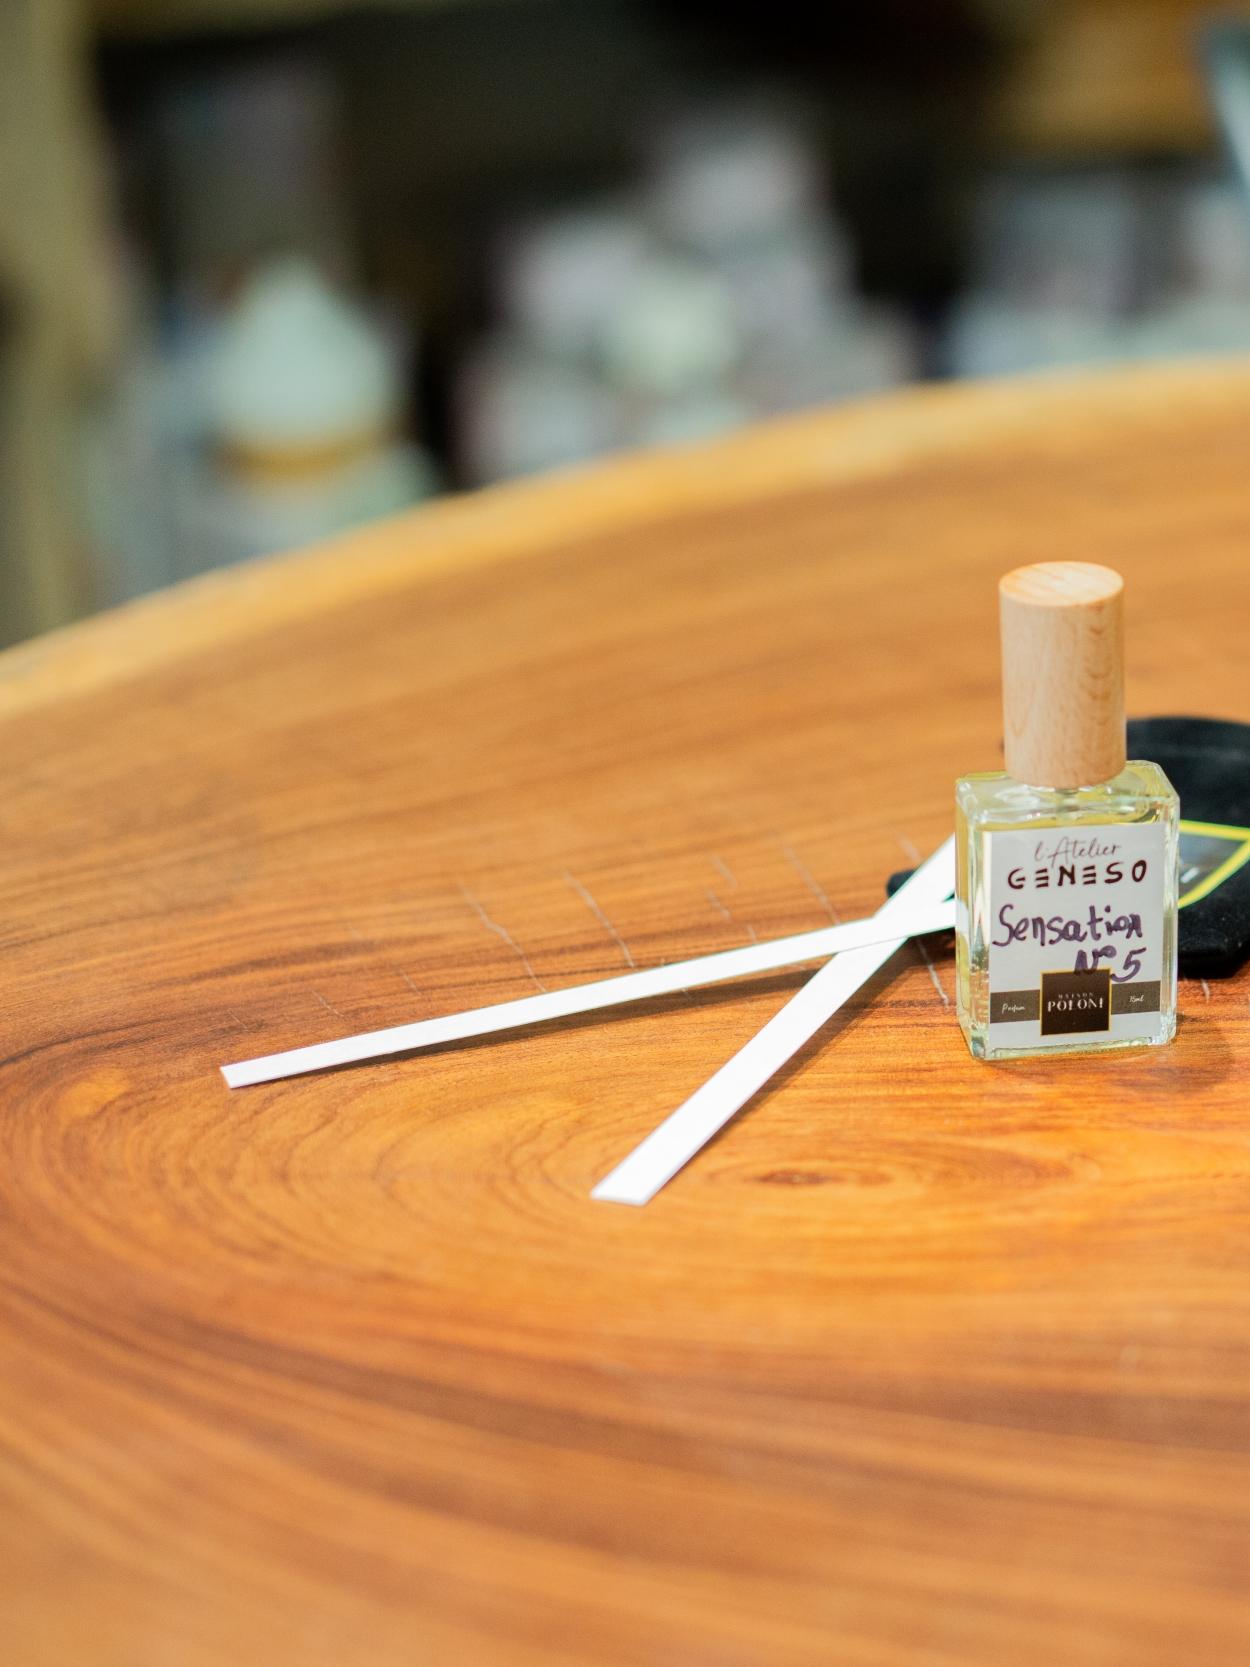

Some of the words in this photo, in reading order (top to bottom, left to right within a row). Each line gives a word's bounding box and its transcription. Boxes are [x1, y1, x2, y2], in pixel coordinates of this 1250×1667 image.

[1007, 860, 1147, 890] GENESO
[992, 904, 1143, 947] Sensation
[1047, 997, 1103, 1012] POLONI
